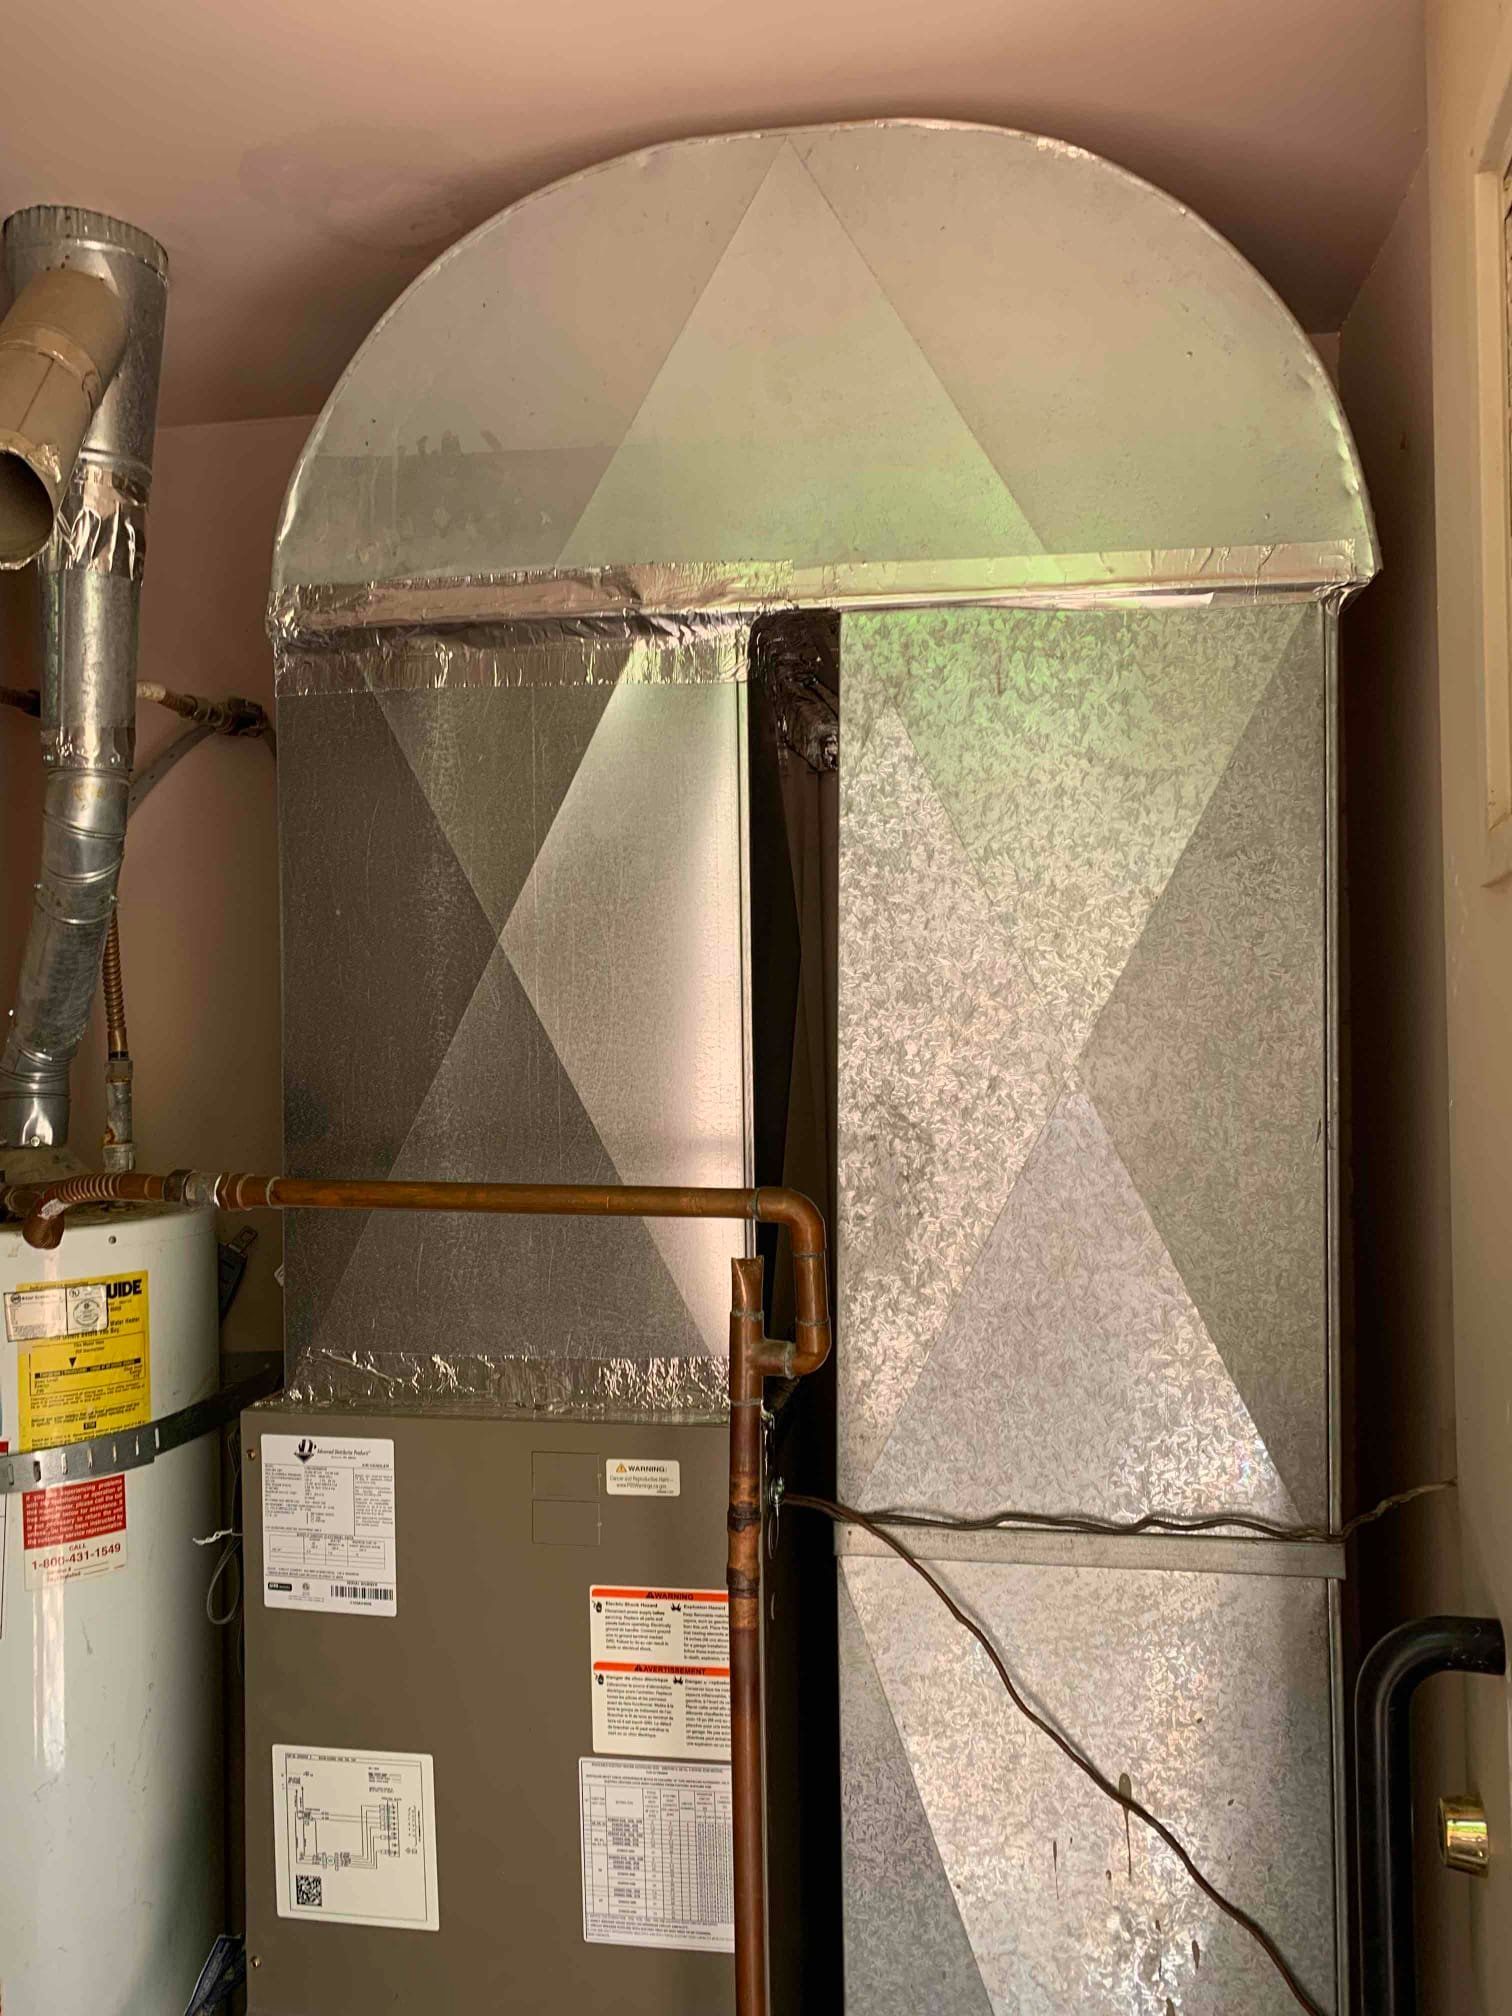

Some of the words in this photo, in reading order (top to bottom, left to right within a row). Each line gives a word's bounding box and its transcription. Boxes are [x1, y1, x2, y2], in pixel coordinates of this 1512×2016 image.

[68, 1543, 87, 1552] CALL
[32, 1543, 121, 1570] 1-800-431-1549
[654, 1592, 694, 1600] WARNING
